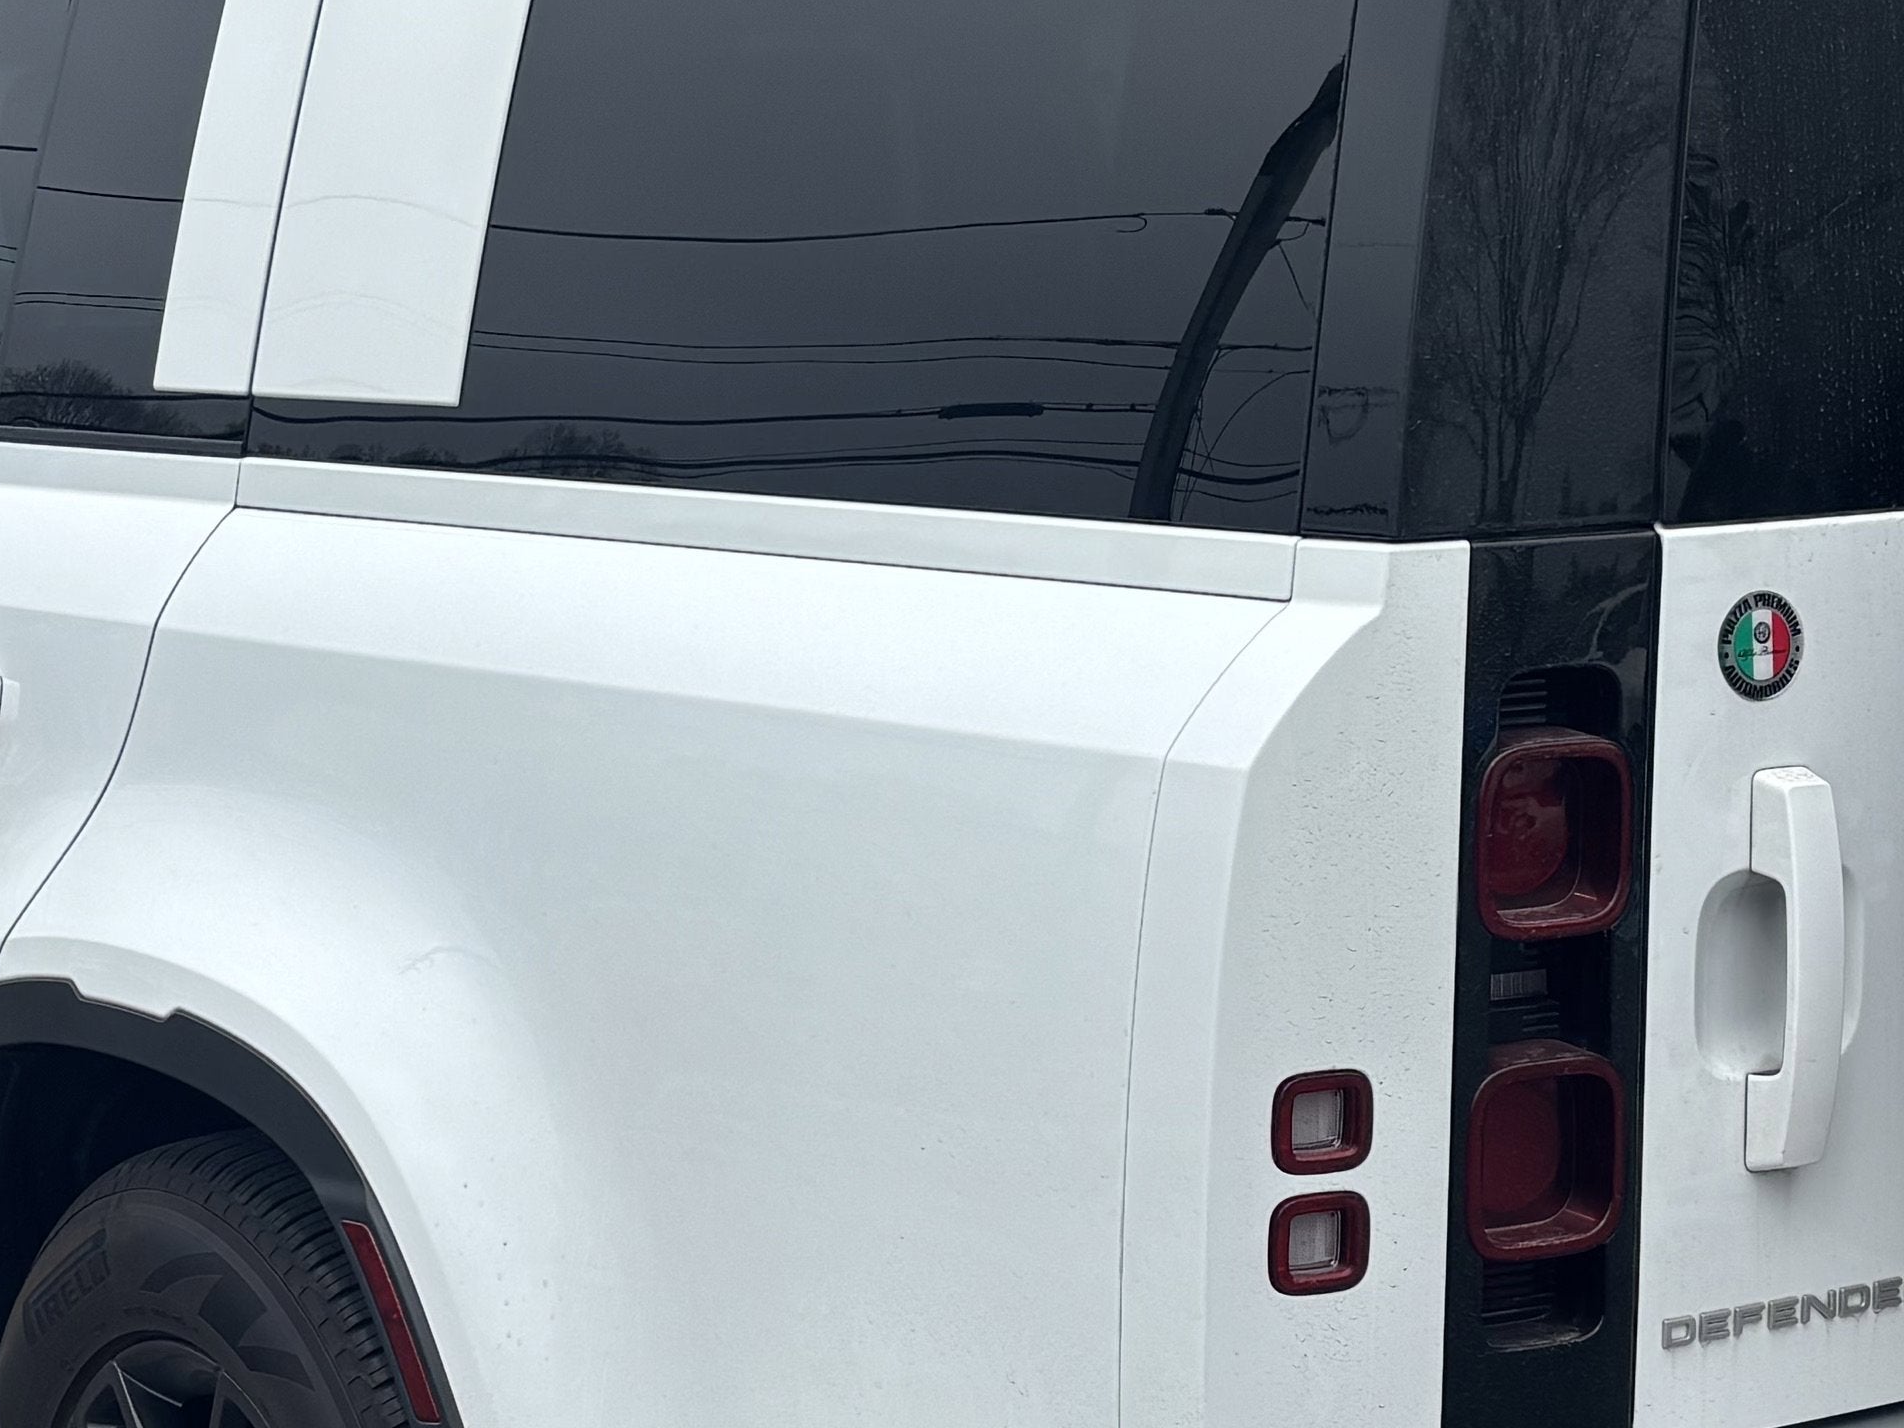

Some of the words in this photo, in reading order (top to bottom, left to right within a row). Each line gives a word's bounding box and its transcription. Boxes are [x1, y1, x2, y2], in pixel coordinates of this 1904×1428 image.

[1722, 598, 1753, 645] PIAZZA
[1753, 593, 1802, 637] PREMIUM
[1724, 658, 1800, 700] AUTOMOBILES
